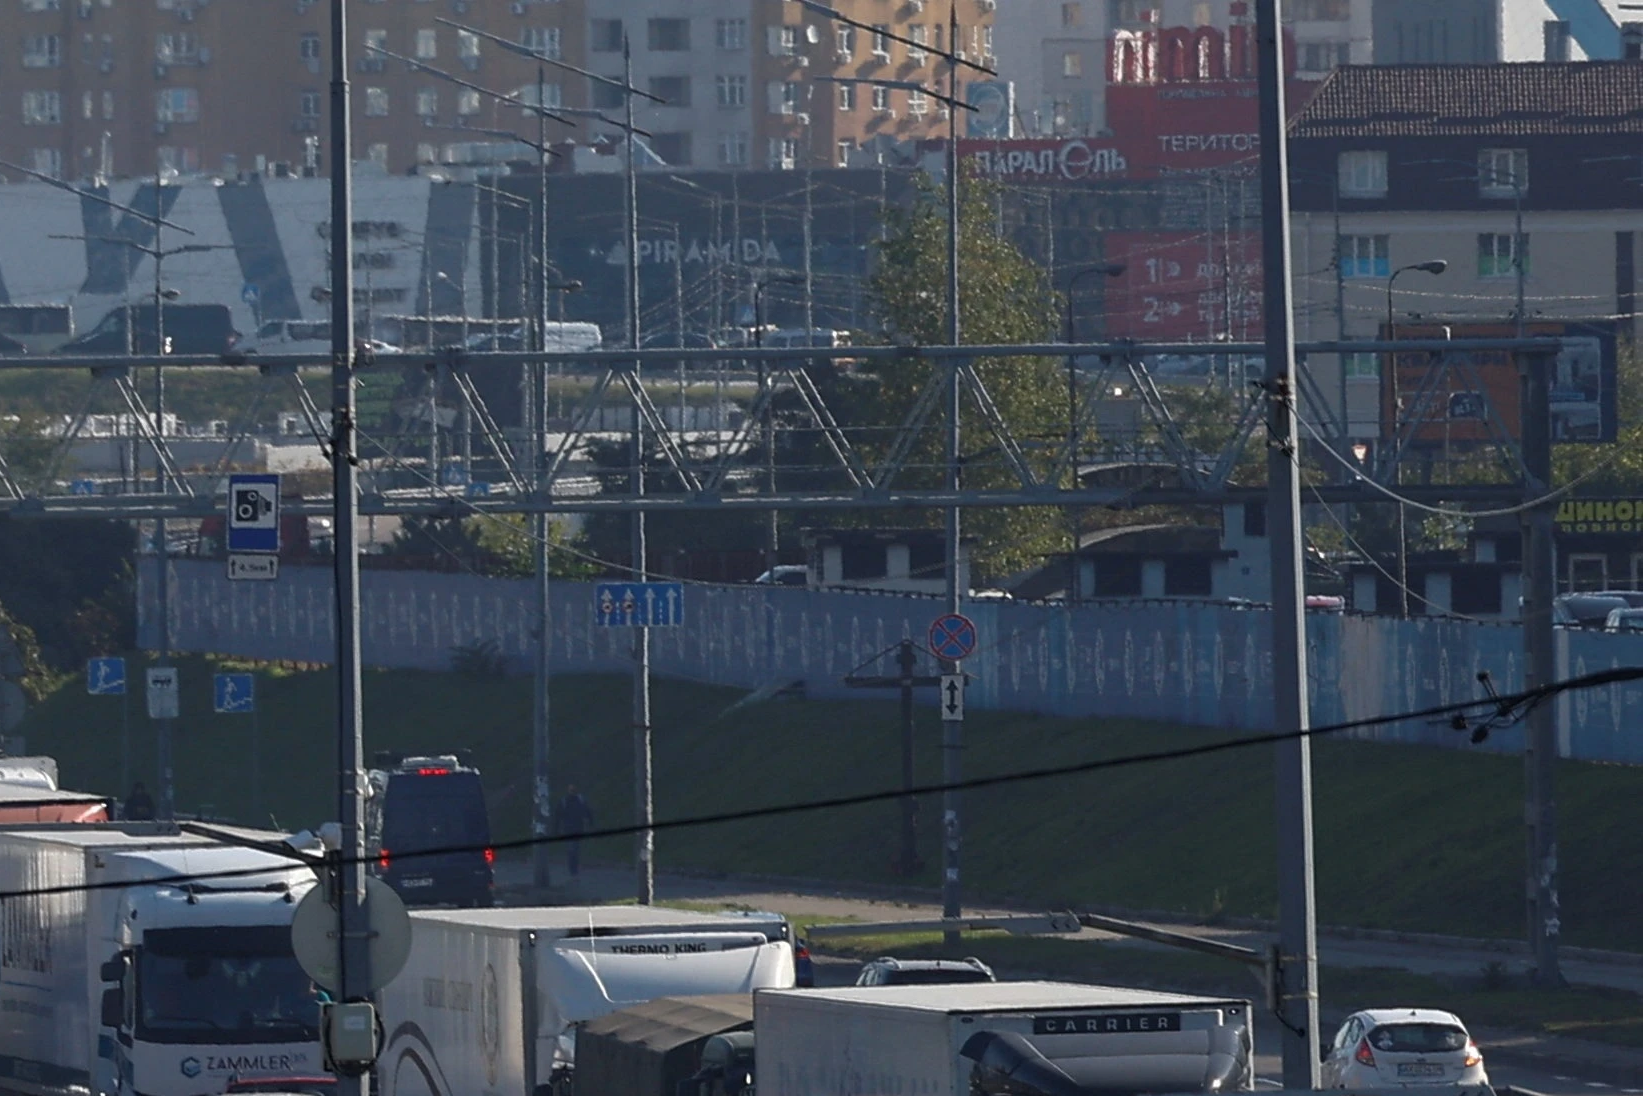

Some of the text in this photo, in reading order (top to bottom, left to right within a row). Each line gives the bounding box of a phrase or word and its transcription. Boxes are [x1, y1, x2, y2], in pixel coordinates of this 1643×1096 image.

[1158, 134, 1260, 152] ТЕРИТОР
[638, 239, 781, 262] PIRAMIDA
[611, 943, 707, 956] THERMO KING
[1045, 1017, 1171, 1032] CARRIER
[206, 1055, 291, 1072] ZAMMLER
